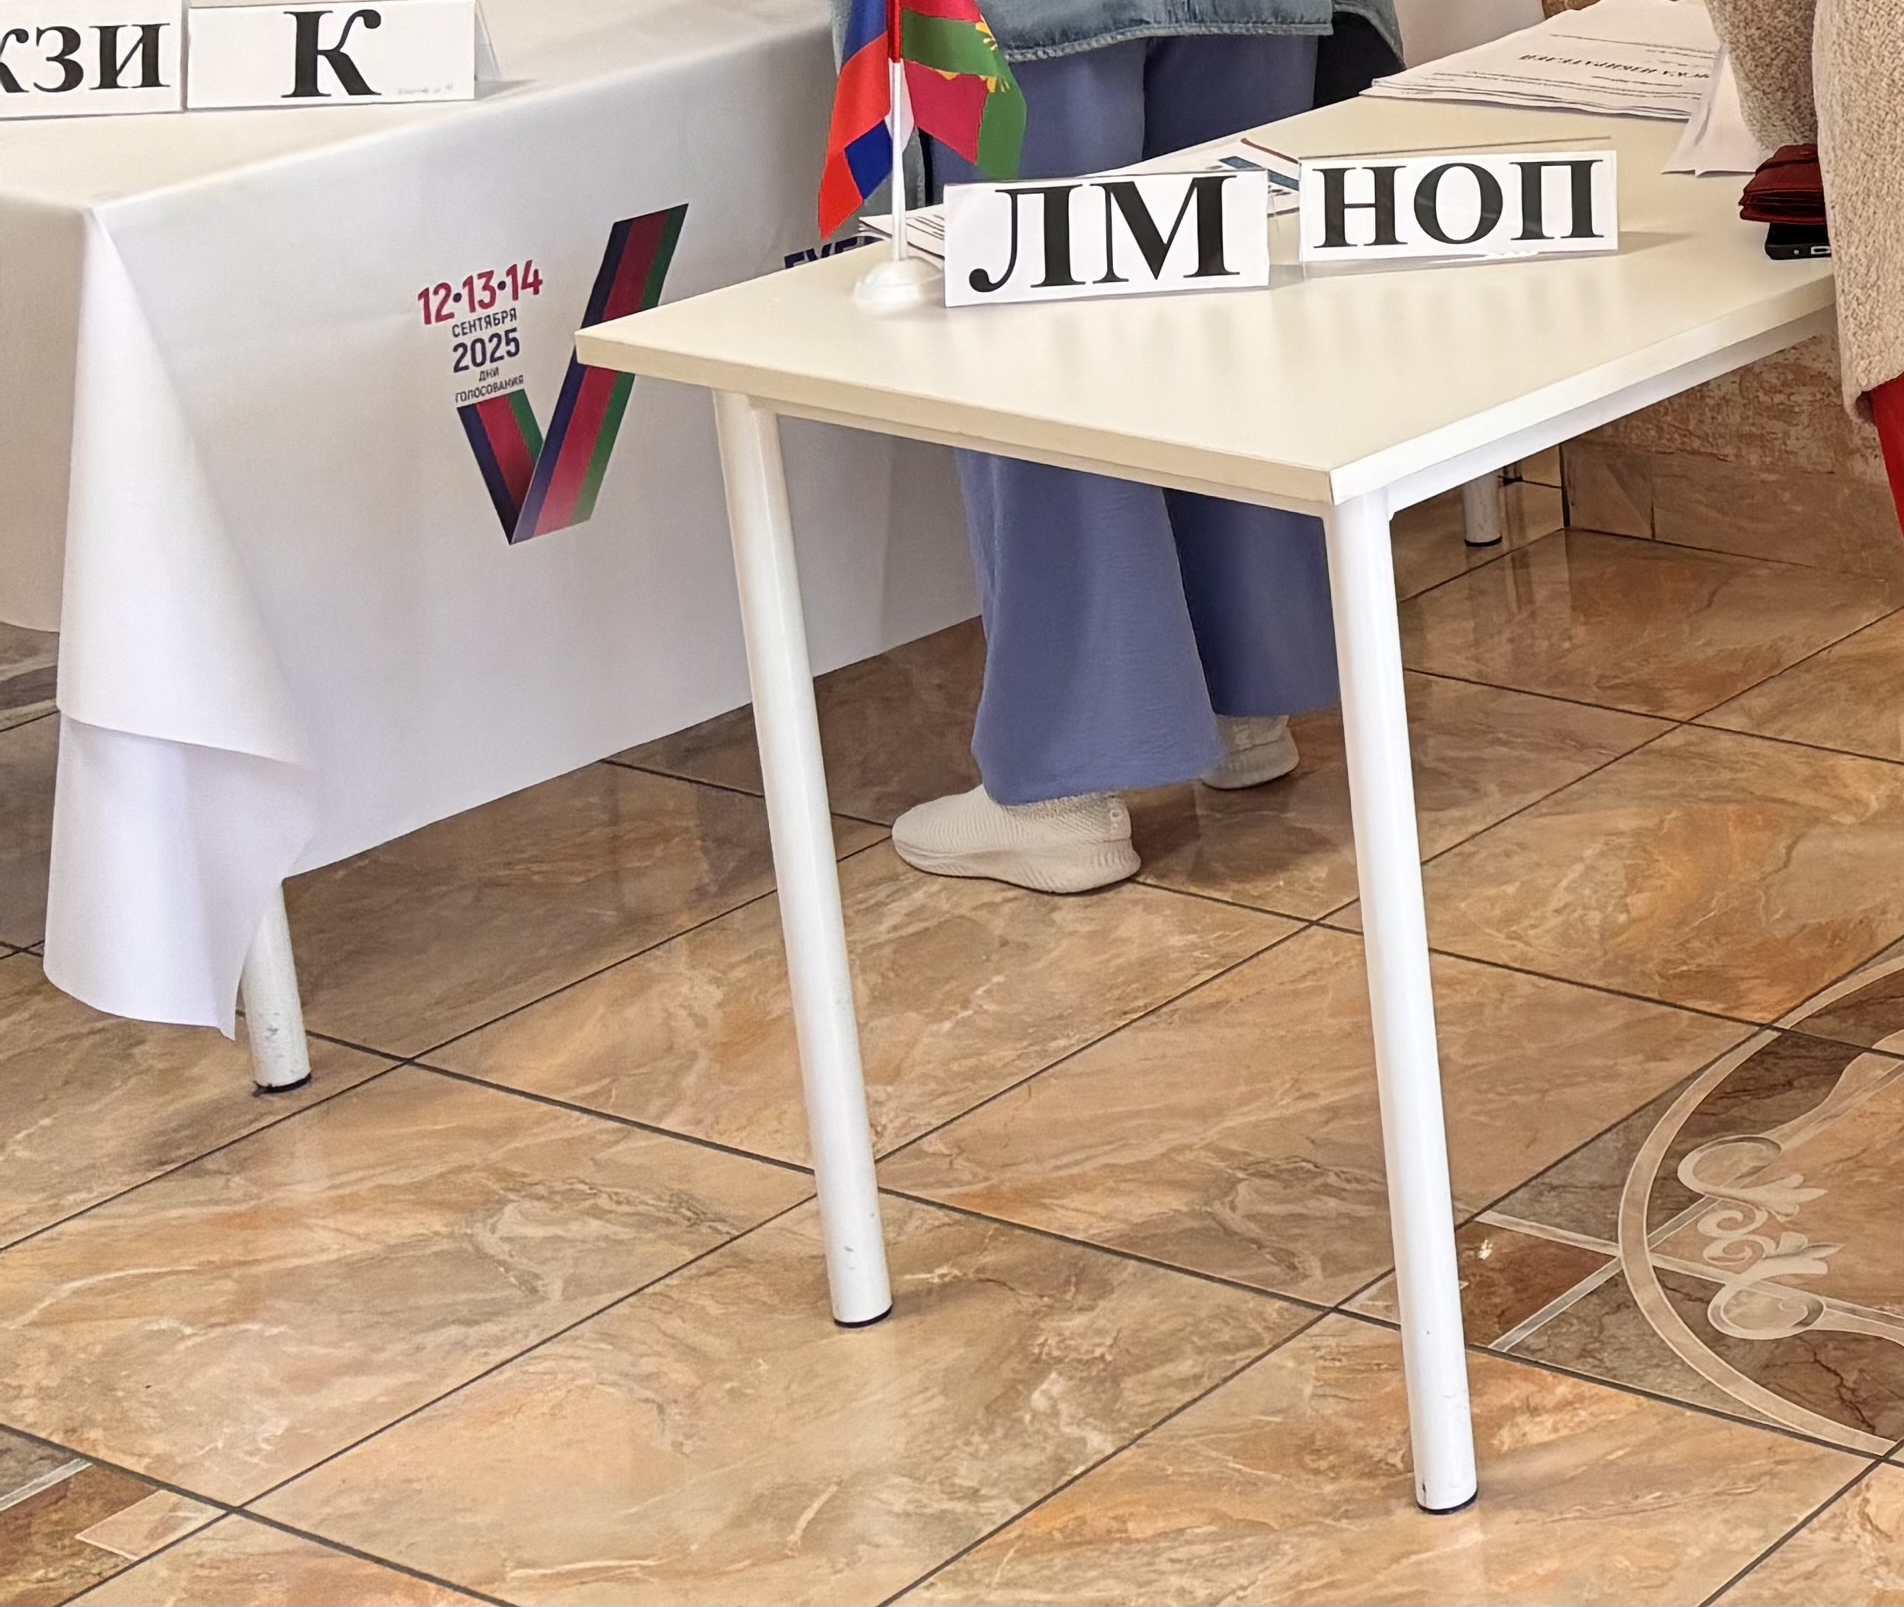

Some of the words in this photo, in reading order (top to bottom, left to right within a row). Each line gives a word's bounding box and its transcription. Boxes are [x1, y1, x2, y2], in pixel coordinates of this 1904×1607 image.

[282, 8, 382, 98] К
[1313, 159, 1604, 248] НОП
[969, 174, 1240, 293] ЛМ
[452, 307, 517, 338] СЕНТЯБРЯ
[453, 327, 520, 374] 2025
[479, 366, 499, 382] ДНИ
[455, 375, 523, 403] ГОЛОСОВАНИЯ
